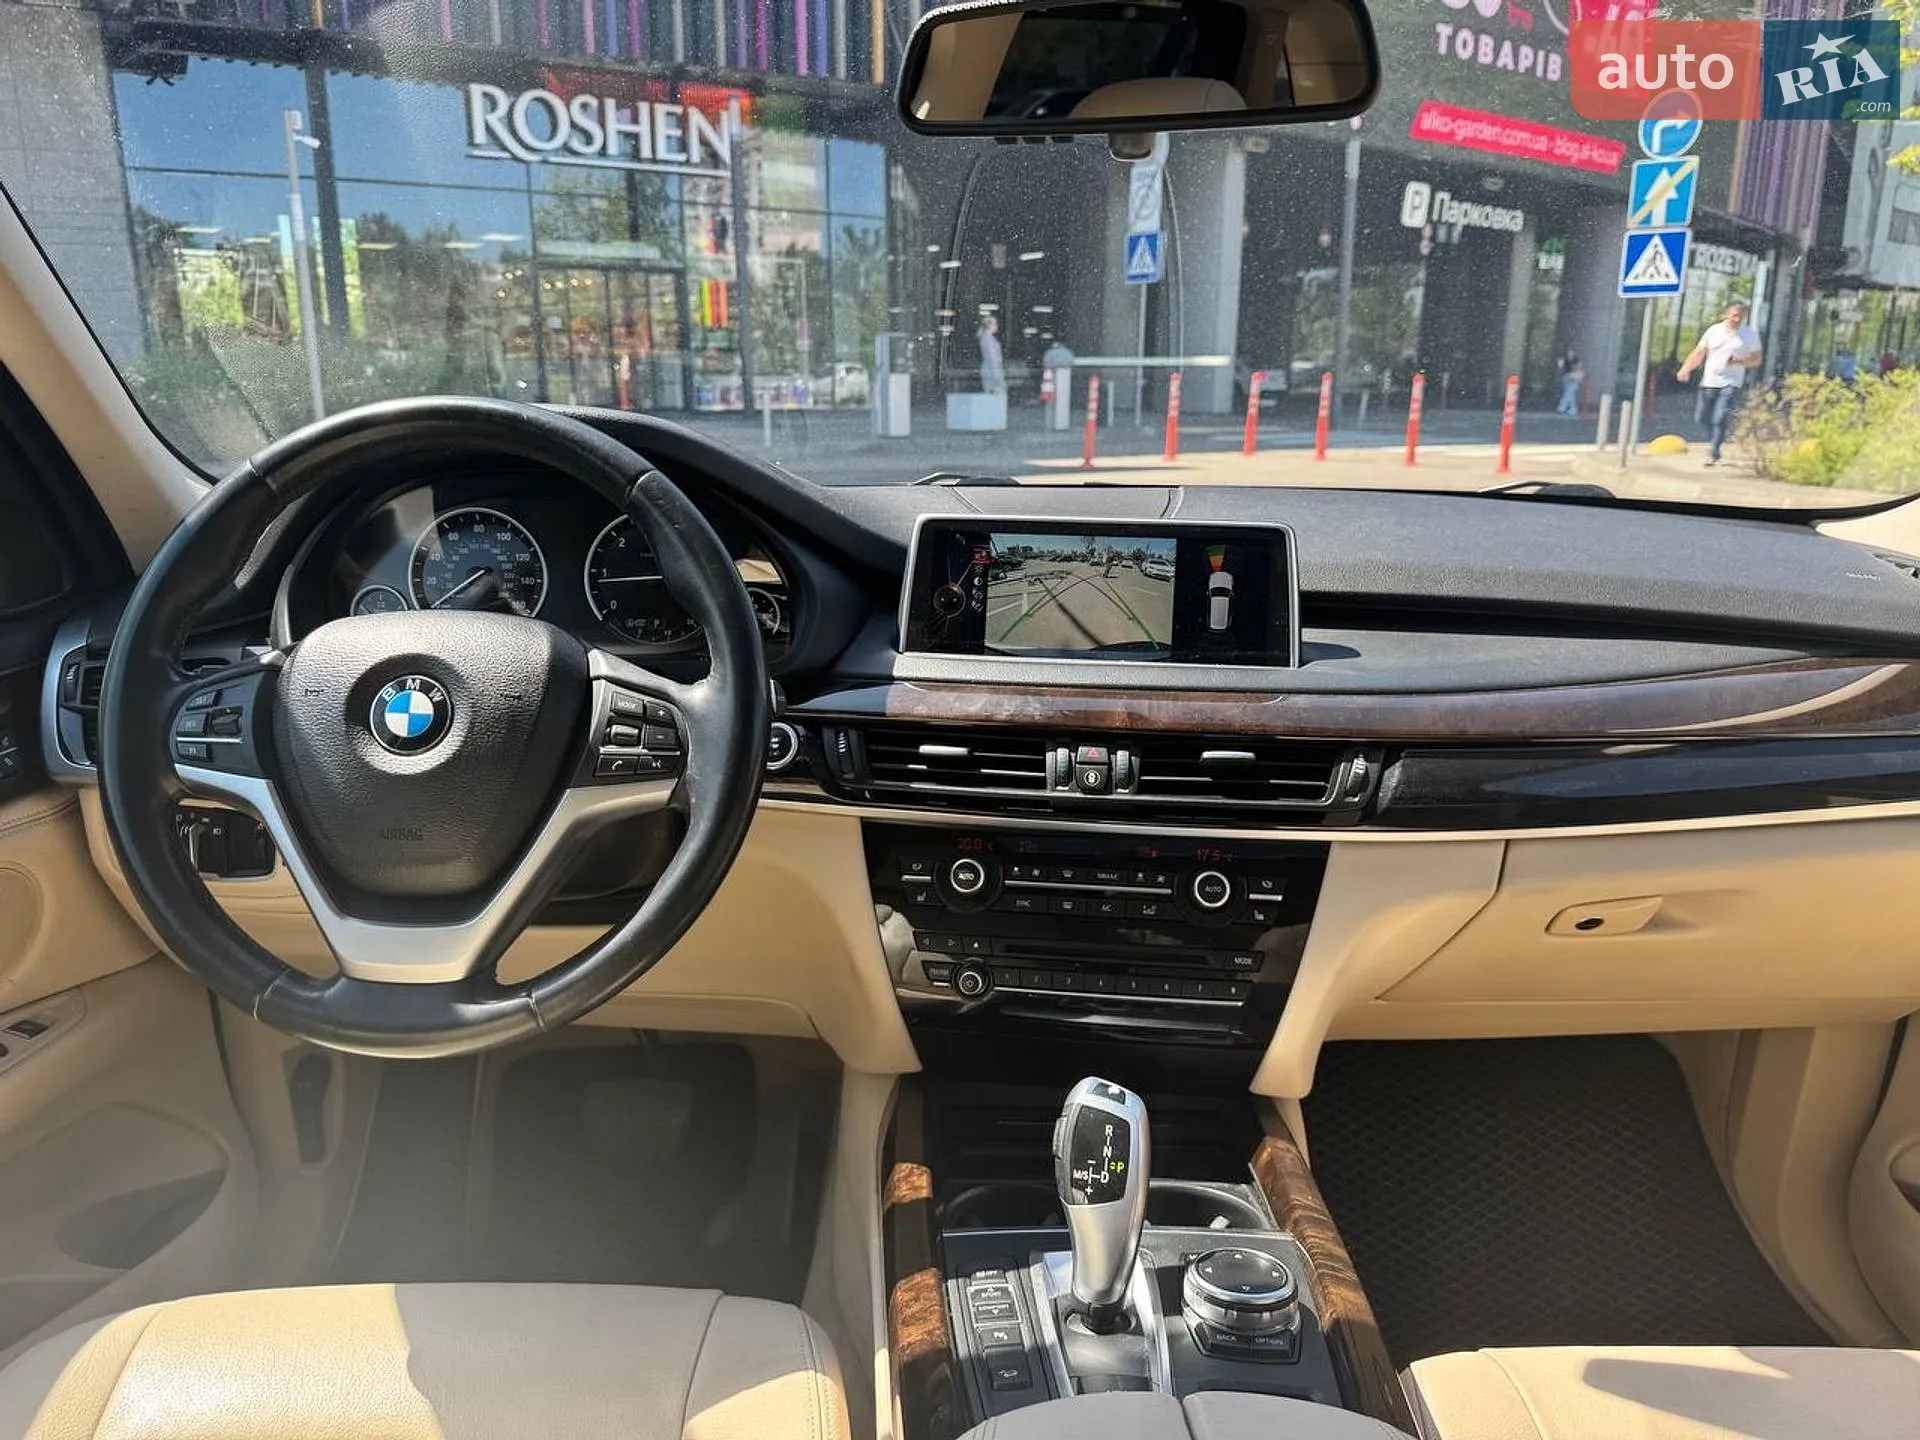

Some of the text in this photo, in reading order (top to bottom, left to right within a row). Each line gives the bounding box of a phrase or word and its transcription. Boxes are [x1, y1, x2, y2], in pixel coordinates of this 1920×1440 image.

[1435, 22, 1562, 81] ТОВАРІВ
[468, 82, 733, 166] ROSHEN
[1432, 191, 1525, 235] Парковка
[496, 532, 512, 541] 100
[618, 538, 626, 548] 2
[515, 552, 531, 561] 120
[610, 600, 618, 610] 0
[381, 678, 444, 702] BMW
[1105, 1124, 1113, 1137] R
[1102, 1145, 1112, 1158] N
[1117, 1162, 1125, 1173] P
[1073, 1168, 1089, 1181] M/S
[1101, 1170, 1110, 1184] D
